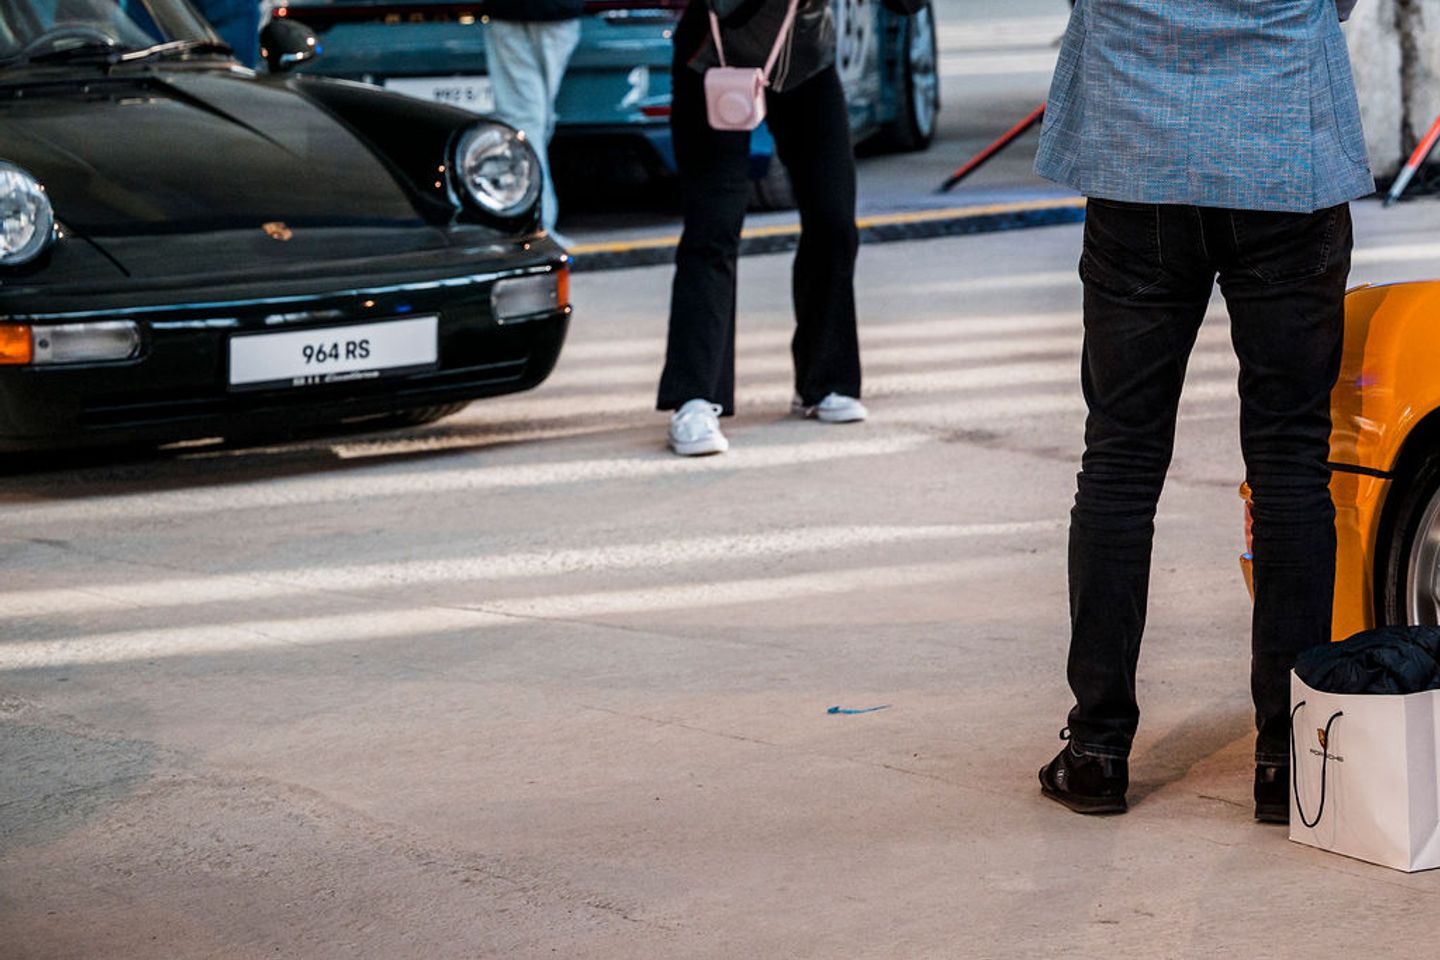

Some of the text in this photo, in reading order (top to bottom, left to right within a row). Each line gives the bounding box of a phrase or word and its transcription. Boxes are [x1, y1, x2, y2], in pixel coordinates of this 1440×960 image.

[302, 339, 370, 364] 964 RS
[1310, 749, 1344, 762] PORCHE
